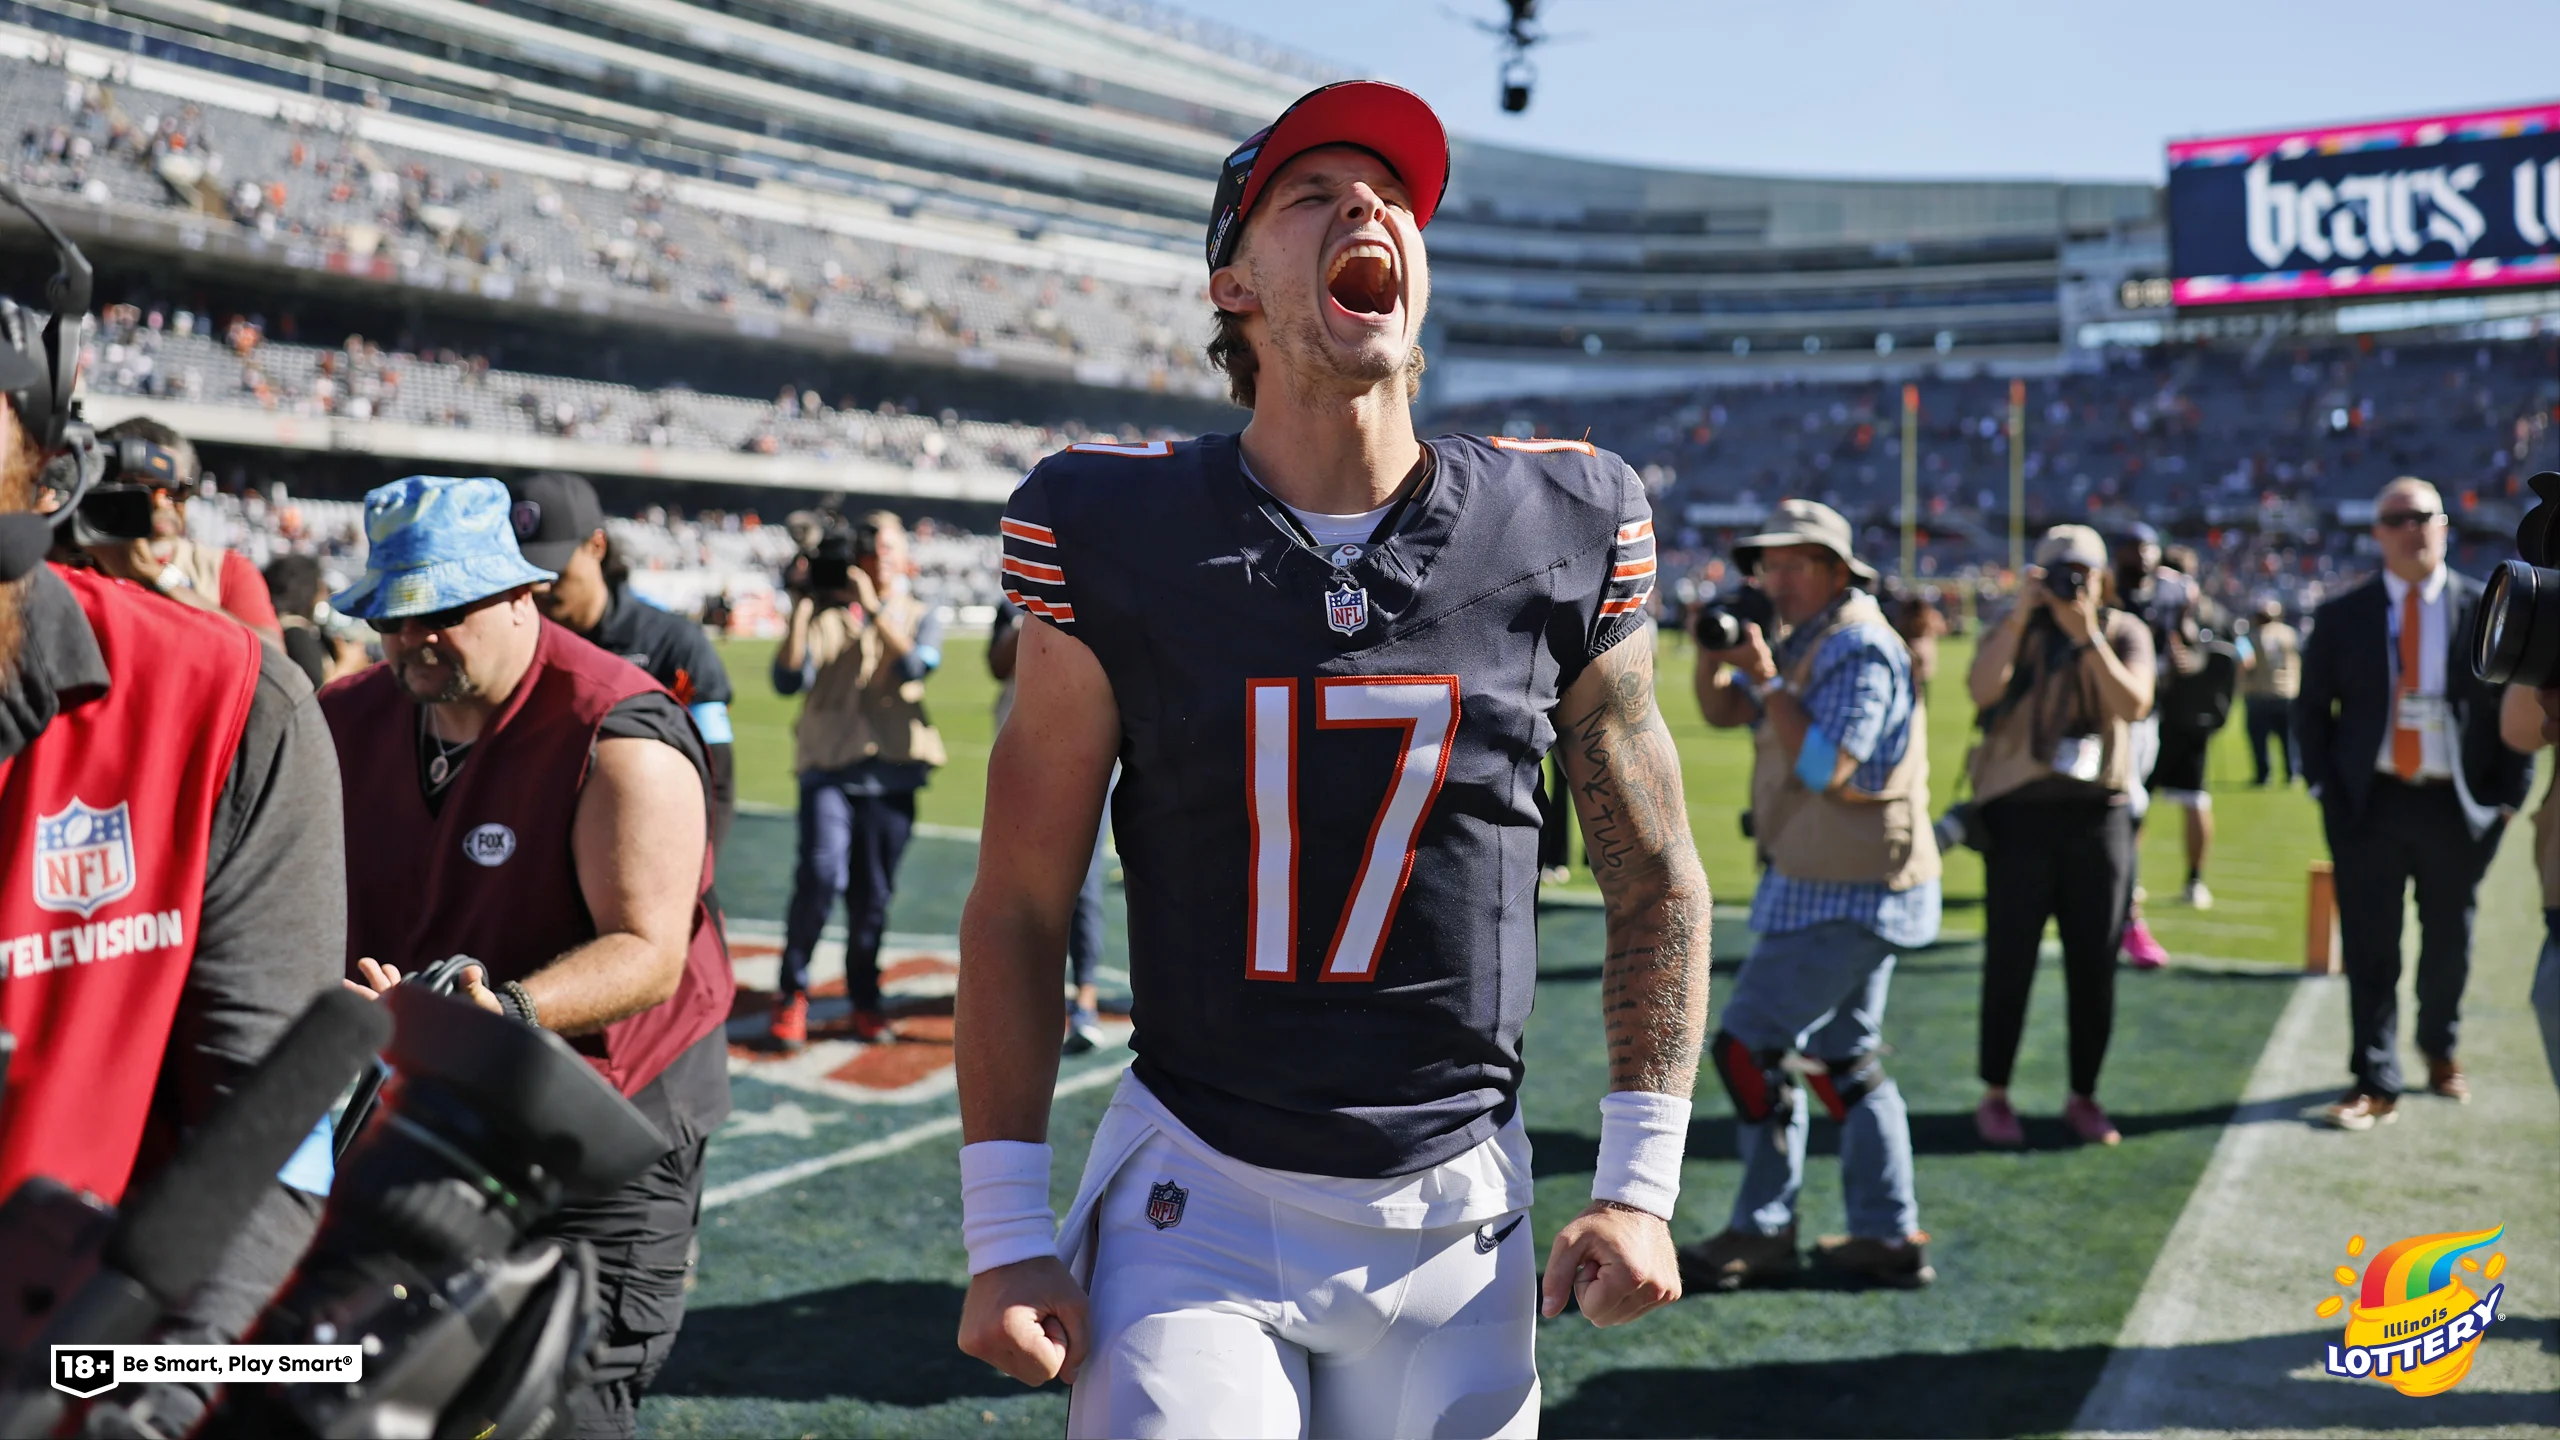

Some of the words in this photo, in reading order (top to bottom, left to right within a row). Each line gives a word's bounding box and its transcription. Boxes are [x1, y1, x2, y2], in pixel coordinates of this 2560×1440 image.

[2244, 158, 2487, 271] bears
[1333, 606, 1362, 626] NFL
[478, 832, 505, 849] FOX
[1245, 674, 1461, 983] 17
[45, 847, 122, 897] NFL
[0, 909, 183, 980] TELEVISION
[1151, 1200, 1176, 1222] NFL
